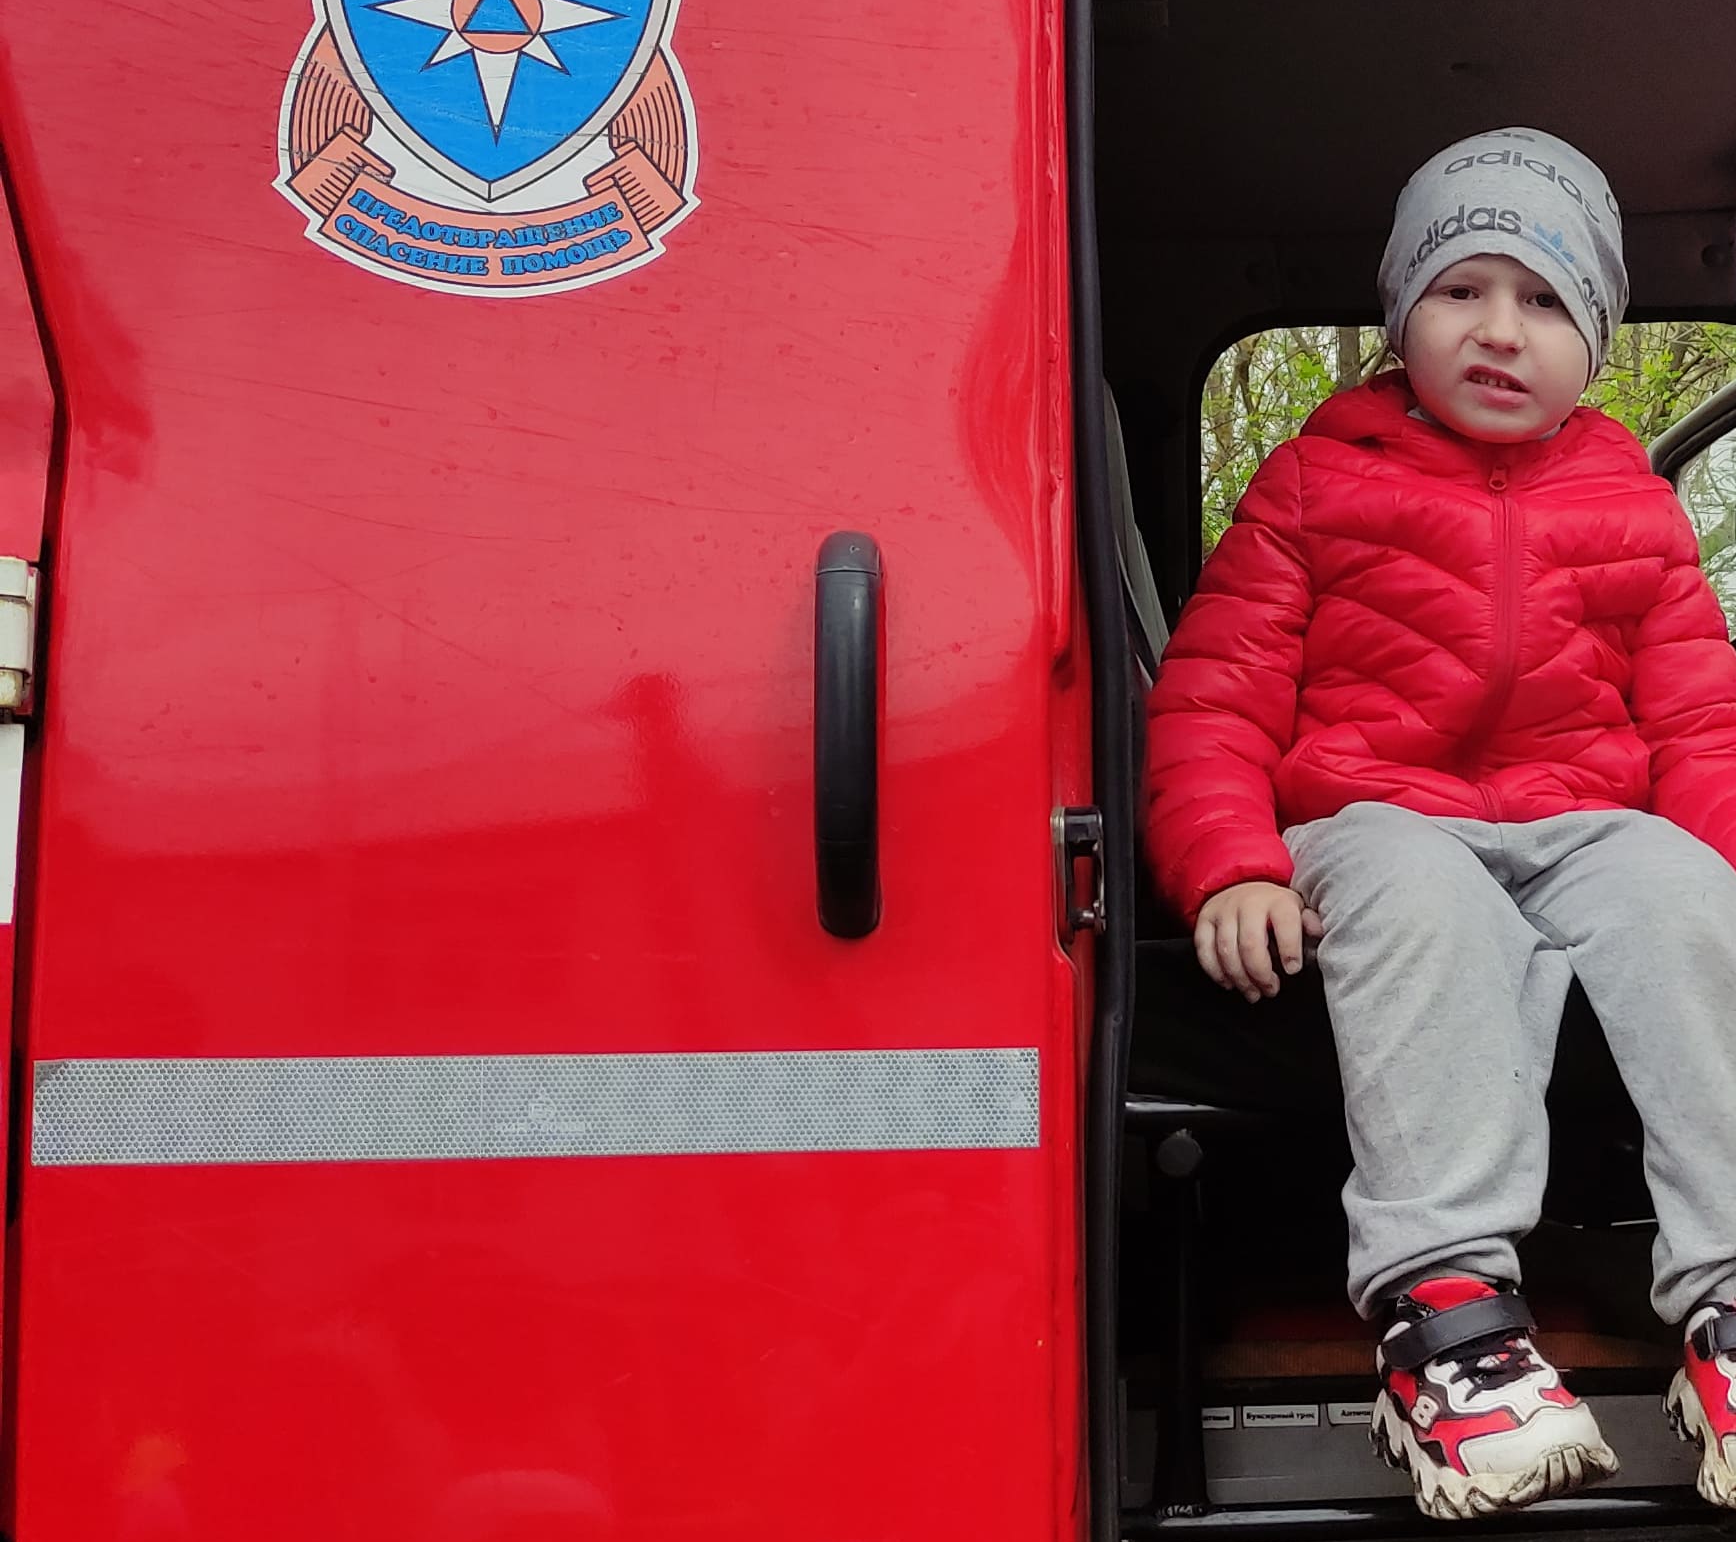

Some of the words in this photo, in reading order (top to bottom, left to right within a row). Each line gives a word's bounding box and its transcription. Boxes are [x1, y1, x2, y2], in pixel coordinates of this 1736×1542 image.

[334, 214, 489, 275] СПАСЕНИЕ
[501, 229, 632, 275] ПОМОЩЬ
[347, 188, 623, 249] ПРЕДОТВРАЩЕНИЕ
[1404, 204, 1522, 284] adidas
